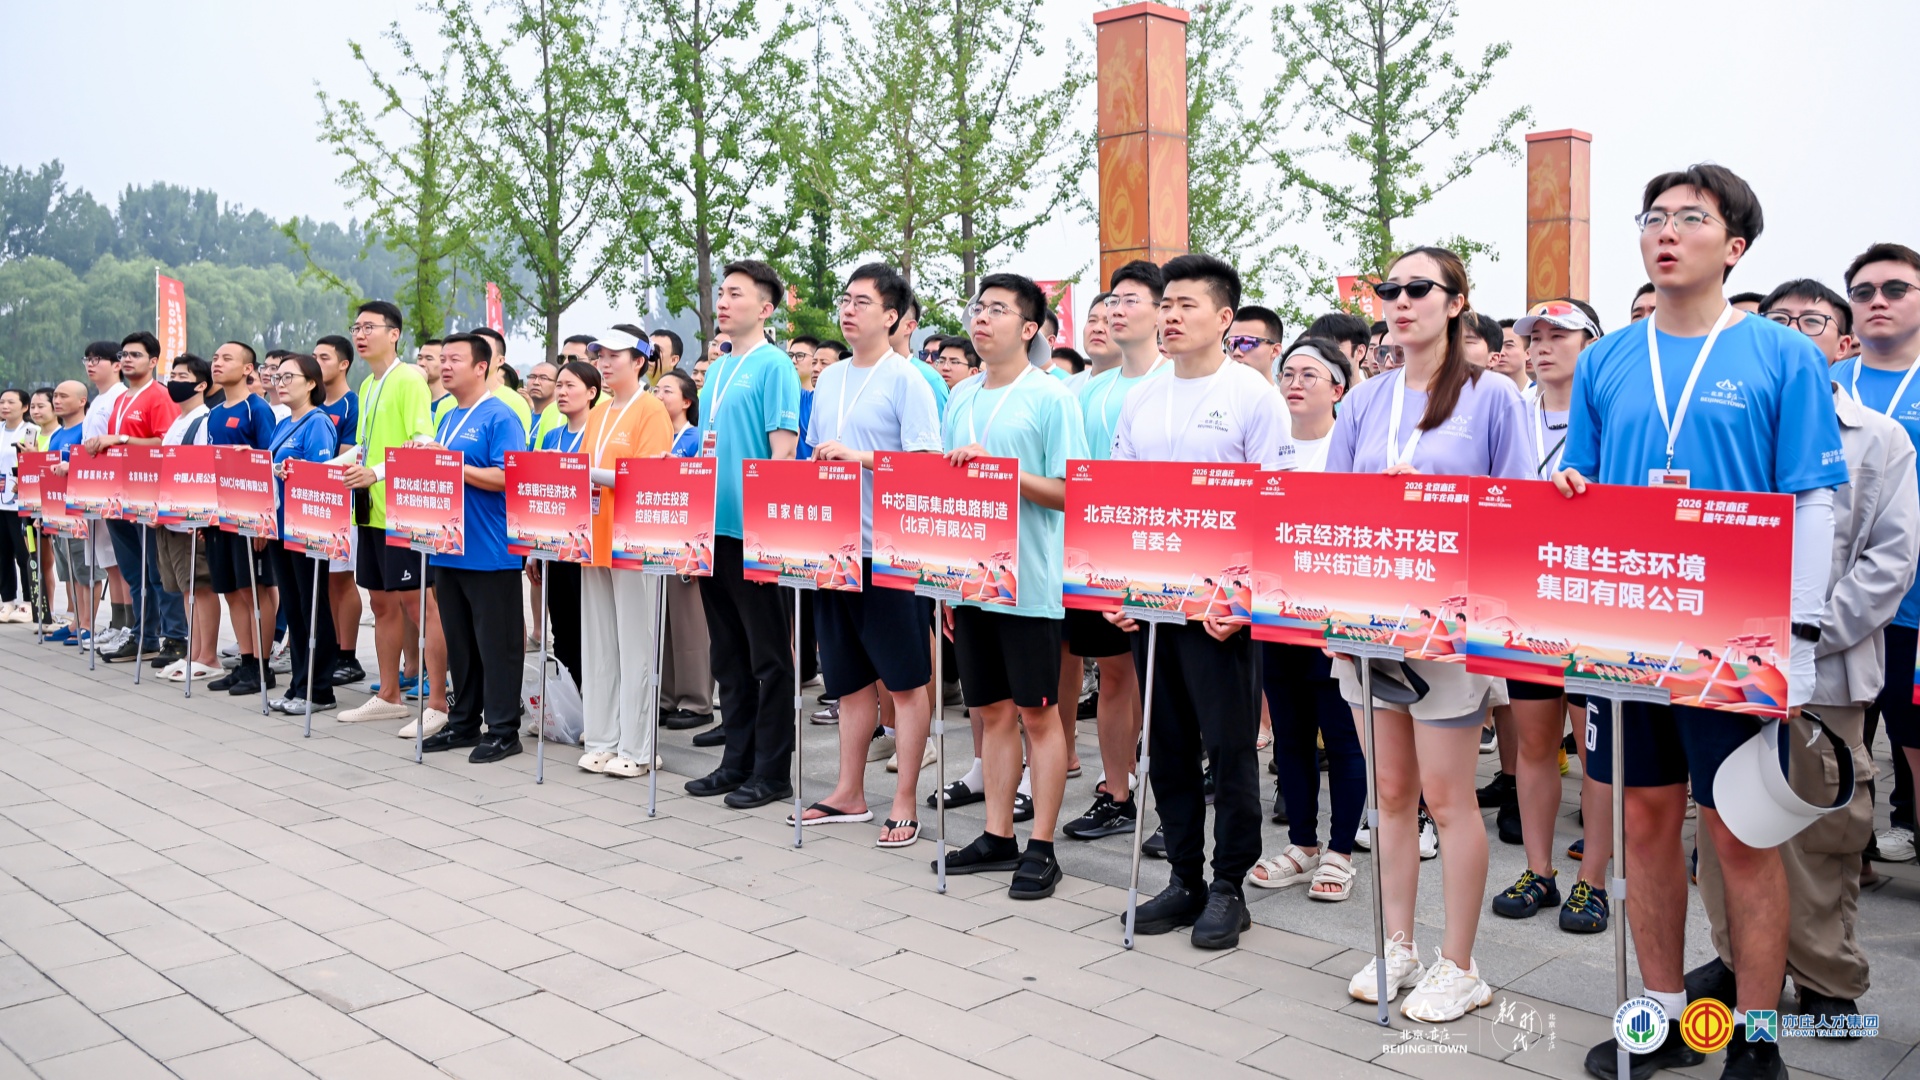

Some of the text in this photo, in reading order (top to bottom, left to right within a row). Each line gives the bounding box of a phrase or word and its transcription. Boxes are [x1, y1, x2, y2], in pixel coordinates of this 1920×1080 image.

[1192, 468, 1208, 476] 2026
[517, 482, 577, 499] 北京银行经济技术
[1404, 481, 1423, 490] 2026
[290, 486, 344, 507] 北京经济技术开发区
[396, 492, 451, 511] 技术股份有限公司
[635, 490, 689, 507] 北京亦庄投资
[881, 491, 1008, 521] 中芯国际集成电路制造
[1676, 498, 1702, 509] 2026
[528, 500, 566, 516] 开发区分行
[635, 509, 688, 525] 控股有限公司
[767, 503, 832, 522] 国家信创园
[1083, 504, 1237, 530] 北京经济技术开发区
[900, 514, 986, 541] (北京)有限公司
[1131, 530, 1182, 552] 管委会
[1275, 522, 1459, 554] 北京经济技术开发区
[1293, 550, 1436, 582] 博兴街道办事处
[1537, 541, 1706, 582] 中建生态环境
[1536, 573, 1705, 616] 集团有限公司
